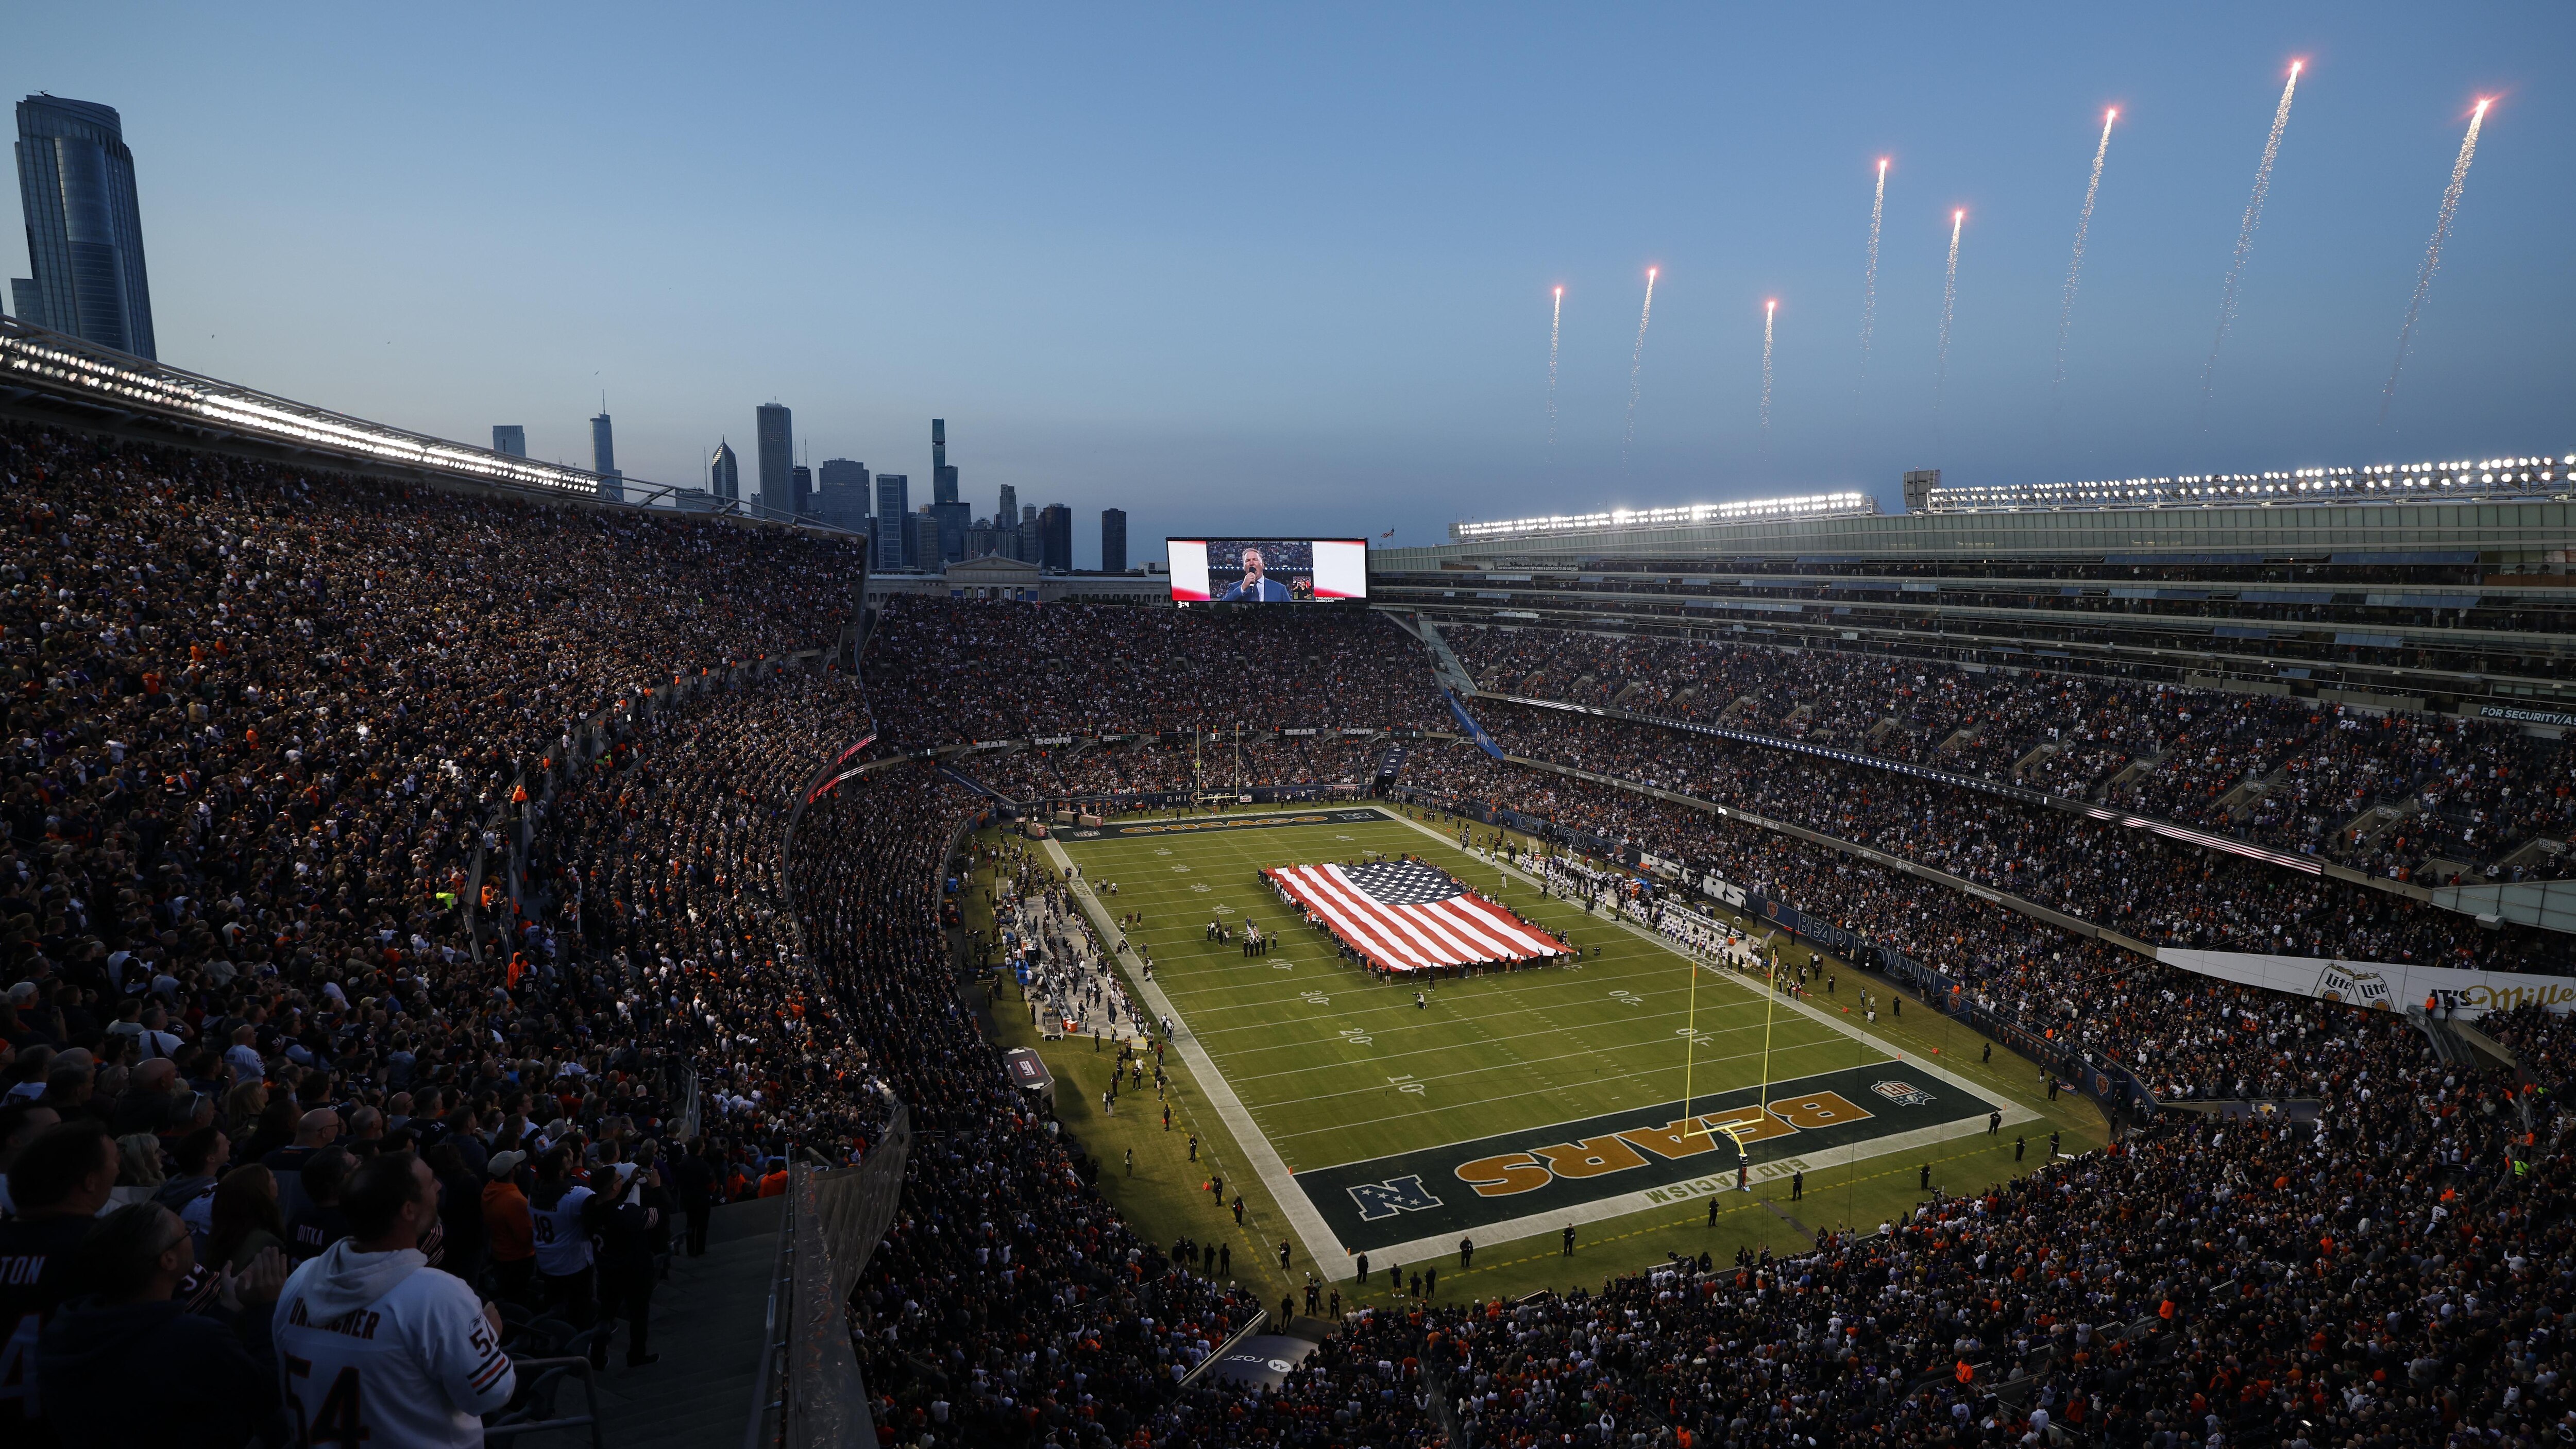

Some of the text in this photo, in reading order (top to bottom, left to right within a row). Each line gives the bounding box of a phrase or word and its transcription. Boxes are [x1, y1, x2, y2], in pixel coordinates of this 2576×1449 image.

[2481, 707, 2503, 718] FOR
[1035, 737, 1072, 745] DOWN
[1480, 732, 1489, 747] PNC
[1120, 816, 1328, 833] CHICAGO
[1739, 813, 1780, 830] SOLDIER FIELD
[2539, 839, 2550, 848] 315
[352, 855, 361, 863] 22
[1902, 863, 1915, 873] PNC
[1191, 882, 1212, 893] 30
[1963, 884, 2002, 904] ticketmaster
[1213, 904, 1235, 915] 40
[1266, 958, 1292, 969] 40
[525, 982, 533, 993] 18
[2325, 973, 2352, 990] Lite
[2360, 983, 2385, 999] Lite
[1300, 990, 1329, 1004] 30
[1608, 990, 1643, 1003] 20
[1340, 1028, 1373, 1046] 20
[1676, 1028, 1715, 1045] 10
[1387, 1073, 1426, 1093] 10
[1878, 1081, 1917, 1097] NFL
[431, 1121, 446, 1132] 34
[1454, 1090, 1876, 1198] BEARS
[581, 1170, 591, 1178] 18
[1756, 1158, 1812, 1182] END
[296, 1224, 325, 1247] DITKA
[534, 1214, 555, 1244] 18
[1224, 1354, 1264, 1363] razr
[283, 1351, 370, 1449] 54
